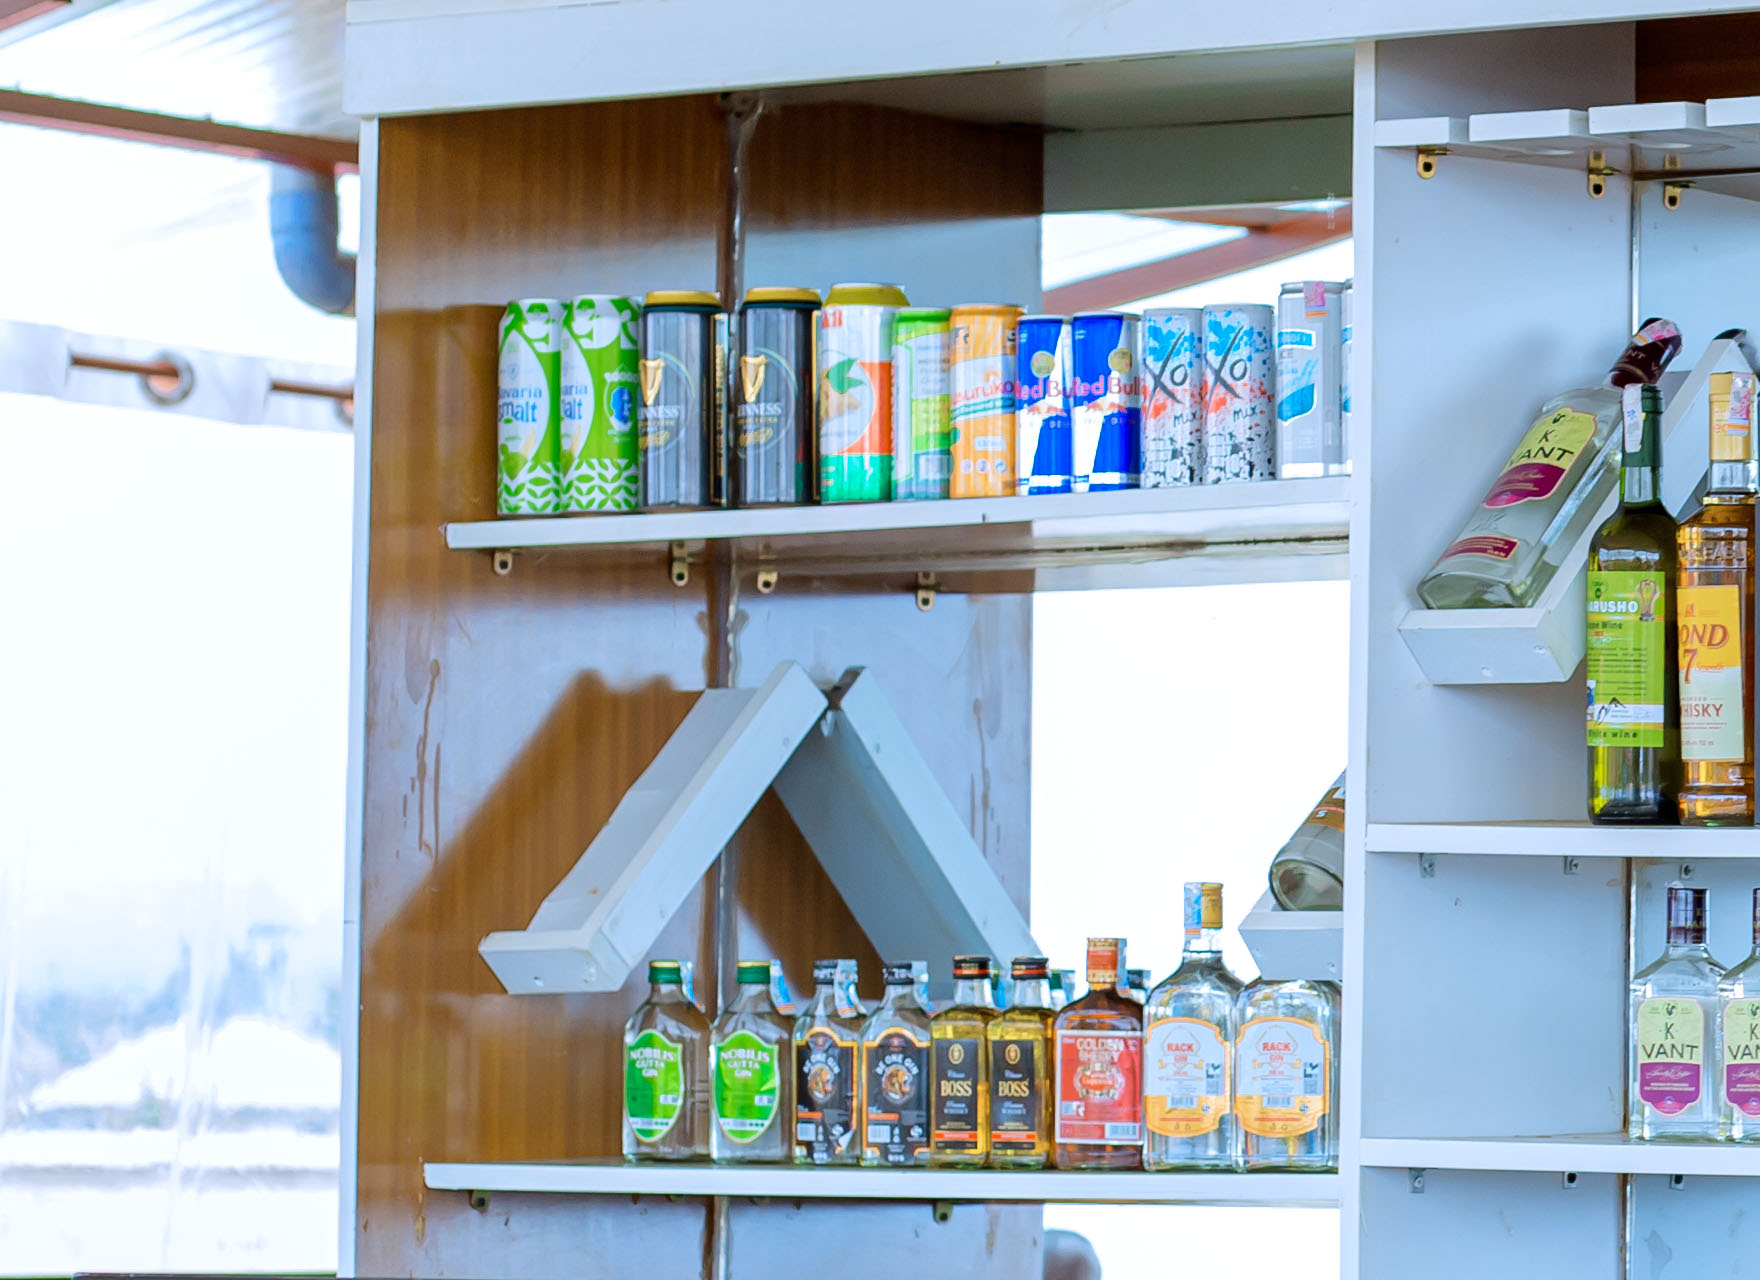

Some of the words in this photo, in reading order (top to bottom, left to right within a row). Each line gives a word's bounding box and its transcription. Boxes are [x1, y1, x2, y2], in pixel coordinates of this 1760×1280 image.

[499, 387, 543, 399] avaria
[562, 384, 588, 396] aria
[562, 399, 583, 420] alt
[1683, 648, 1698, 685] 7
[1665, 1023, 1674, 1039] K
[1749, 1023, 1758, 1040] K
[1076, 1038, 1124, 1051] GOLDEN
[1167, 1042, 1194, 1053] RACK
[1262, 1041, 1292, 1053] RACK
[1641, 1043, 1699, 1061] VANT
[630, 1047, 674, 1062] NOBILIS
[721, 1048, 770, 1063] NOBILIS
[636, 1059, 666, 1070] GUTTA
[641, 1068, 658, 1078] GIN
[940, 1079, 972, 1097] BOSS
[998, 1079, 1030, 1097] BOSS
